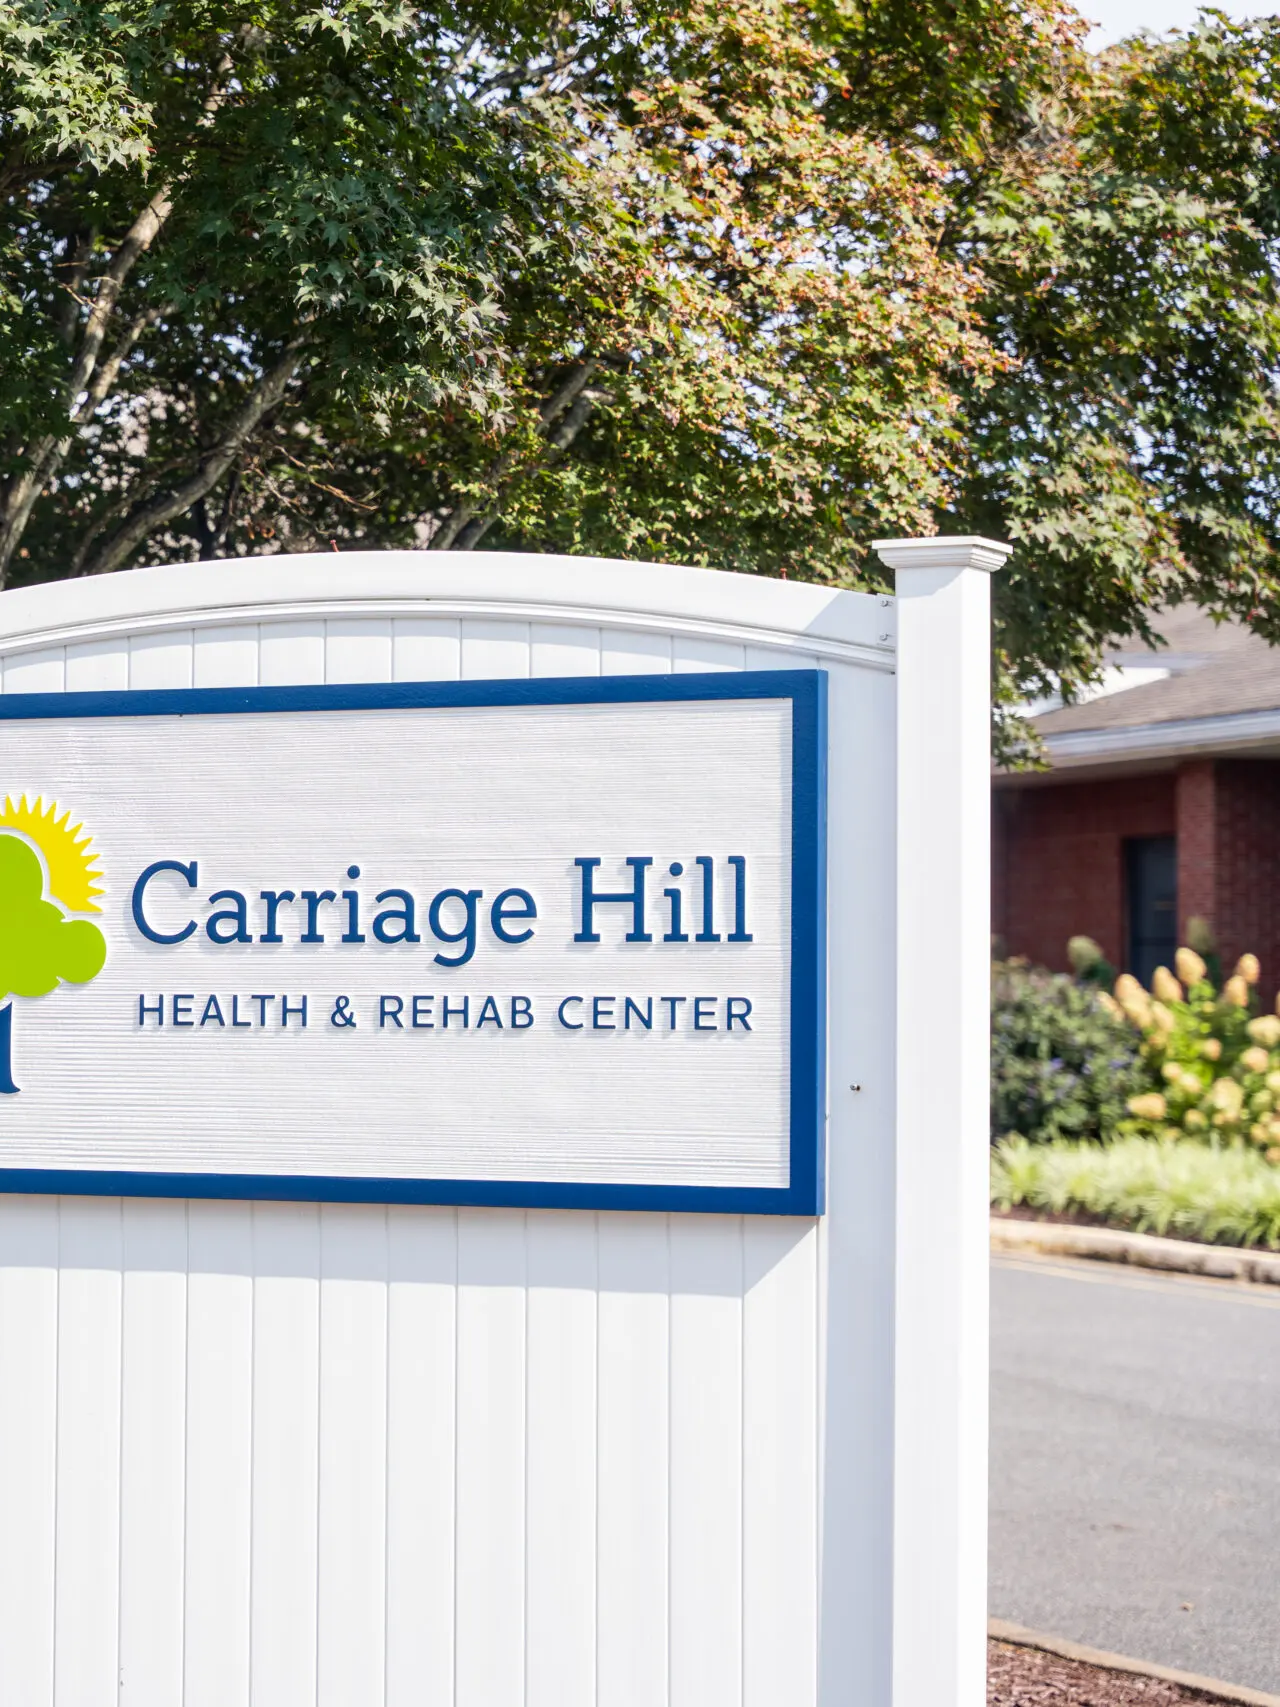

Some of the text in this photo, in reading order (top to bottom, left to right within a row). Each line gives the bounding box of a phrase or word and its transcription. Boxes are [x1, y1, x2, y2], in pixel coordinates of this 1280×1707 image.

[131, 855, 753, 968] Carriage Hill
[139, 994, 752, 1031] HEALTH & REHAB CENTER
